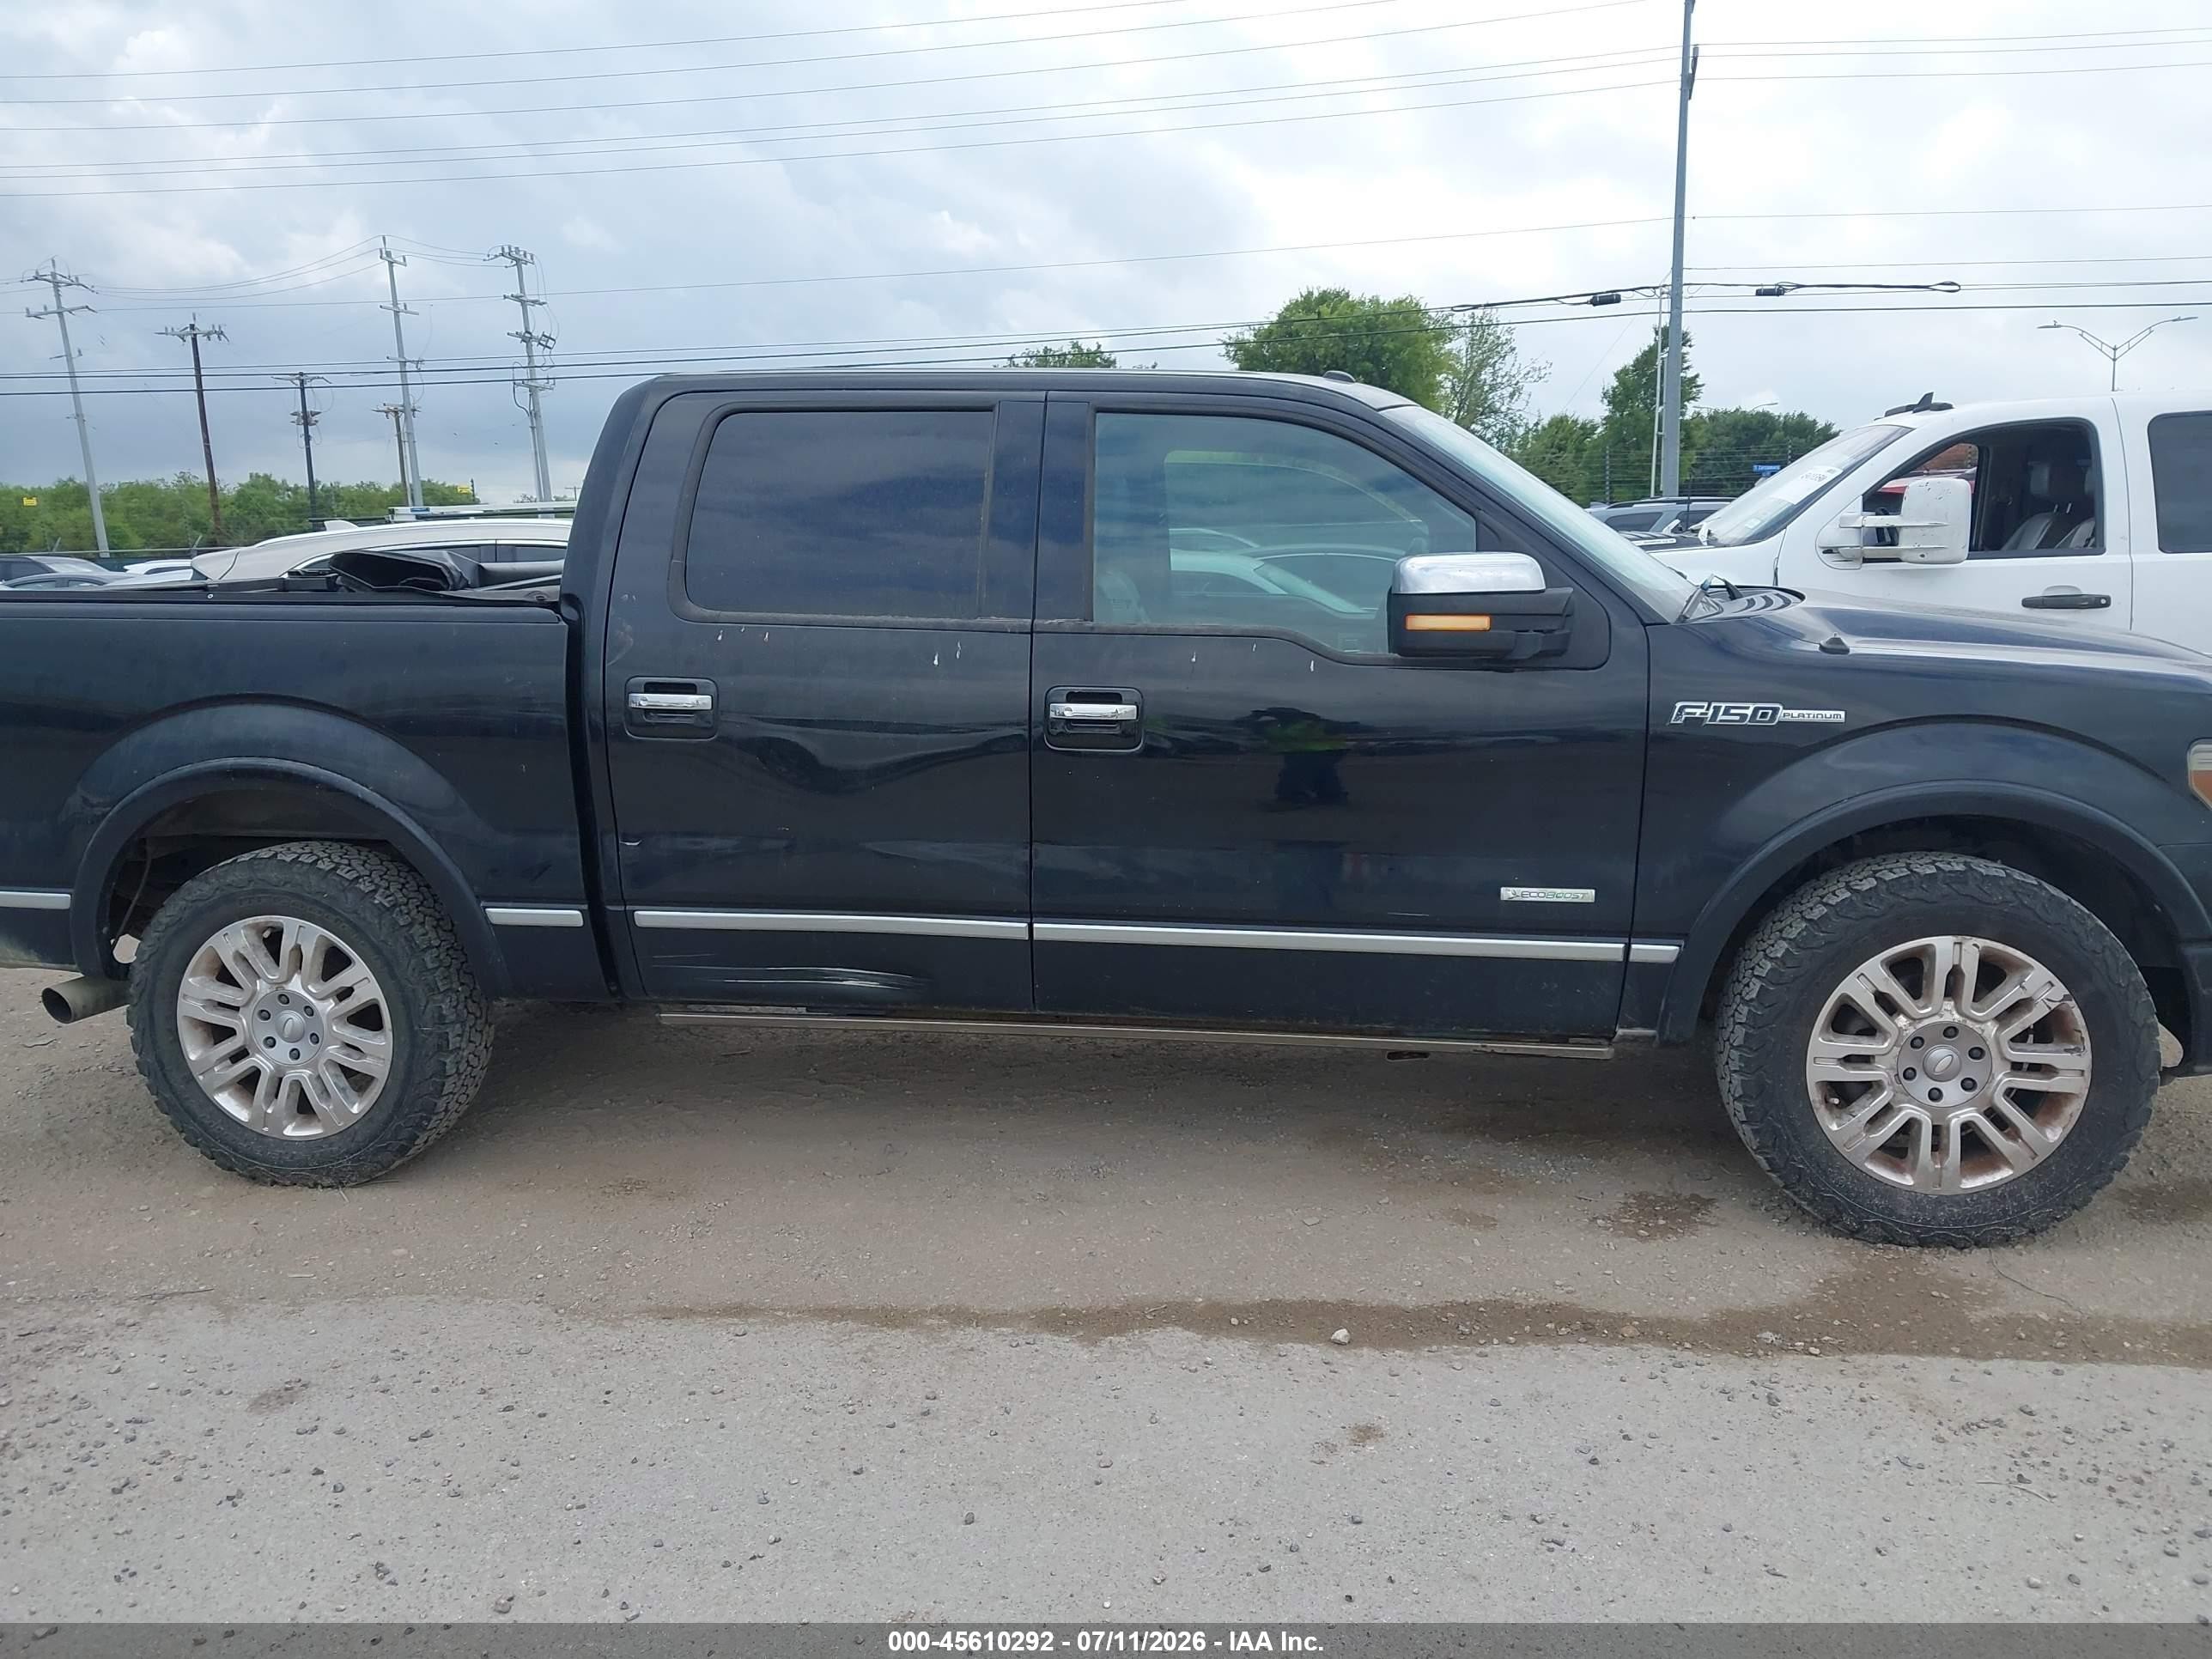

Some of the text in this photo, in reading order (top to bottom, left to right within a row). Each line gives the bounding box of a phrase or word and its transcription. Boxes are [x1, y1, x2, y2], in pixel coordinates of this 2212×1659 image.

[1670, 702, 1843, 725] F-150 PLATINUM
[1520, 890, 1589, 900] ECOBOOST
